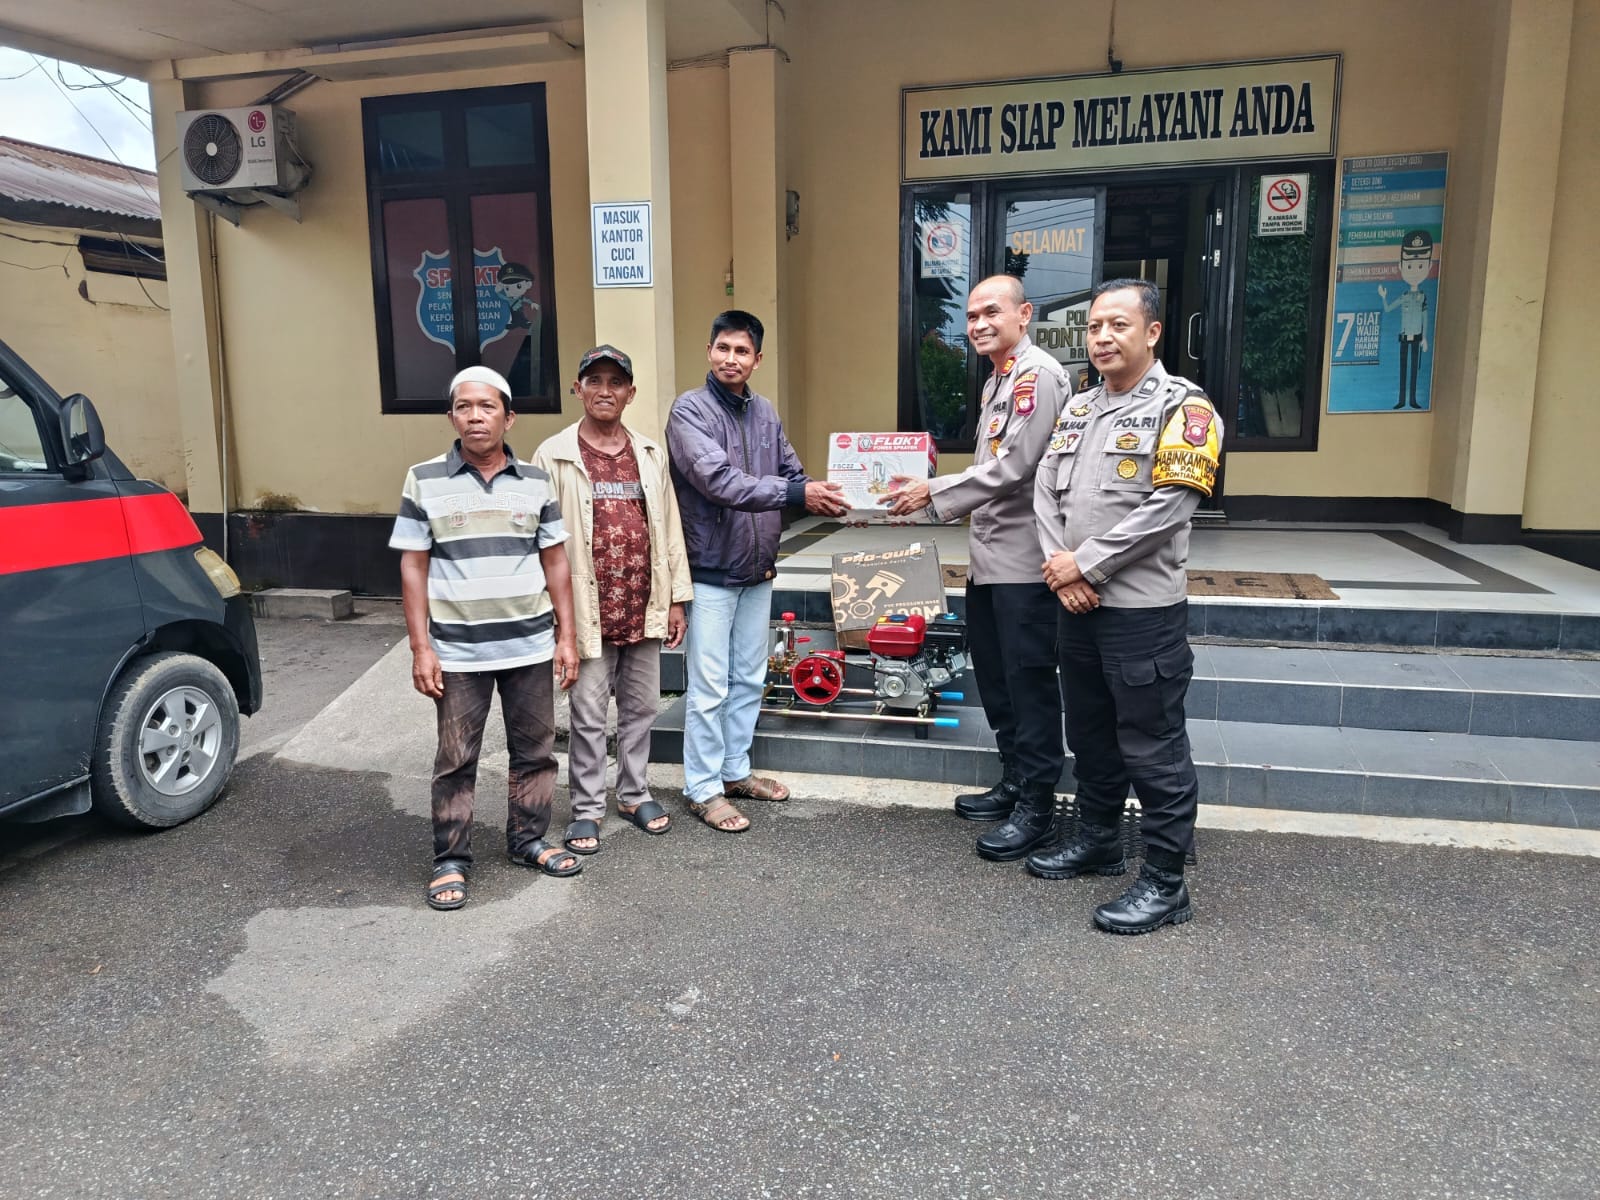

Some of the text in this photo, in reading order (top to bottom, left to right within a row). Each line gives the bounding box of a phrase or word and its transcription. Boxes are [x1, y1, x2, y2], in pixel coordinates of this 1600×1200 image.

[919, 82, 1315, 158] KAMI SIAP MELAYANI ANDA
[250, 136, 266, 148] LG
[603, 209, 641, 225] MASUK
[601, 228, 643, 243] KANTOR
[1011, 227, 1086, 256] SELAMAT
[611, 247, 635, 262] CUCI
[602, 265, 644, 280] TANGAN
[1335, 312, 1381, 357] 7 GIAT
[1356, 325, 1380, 336] WAJIB
[1114, 416, 1157, 428] POLRI
[874, 436, 922, 446] FLOKY
